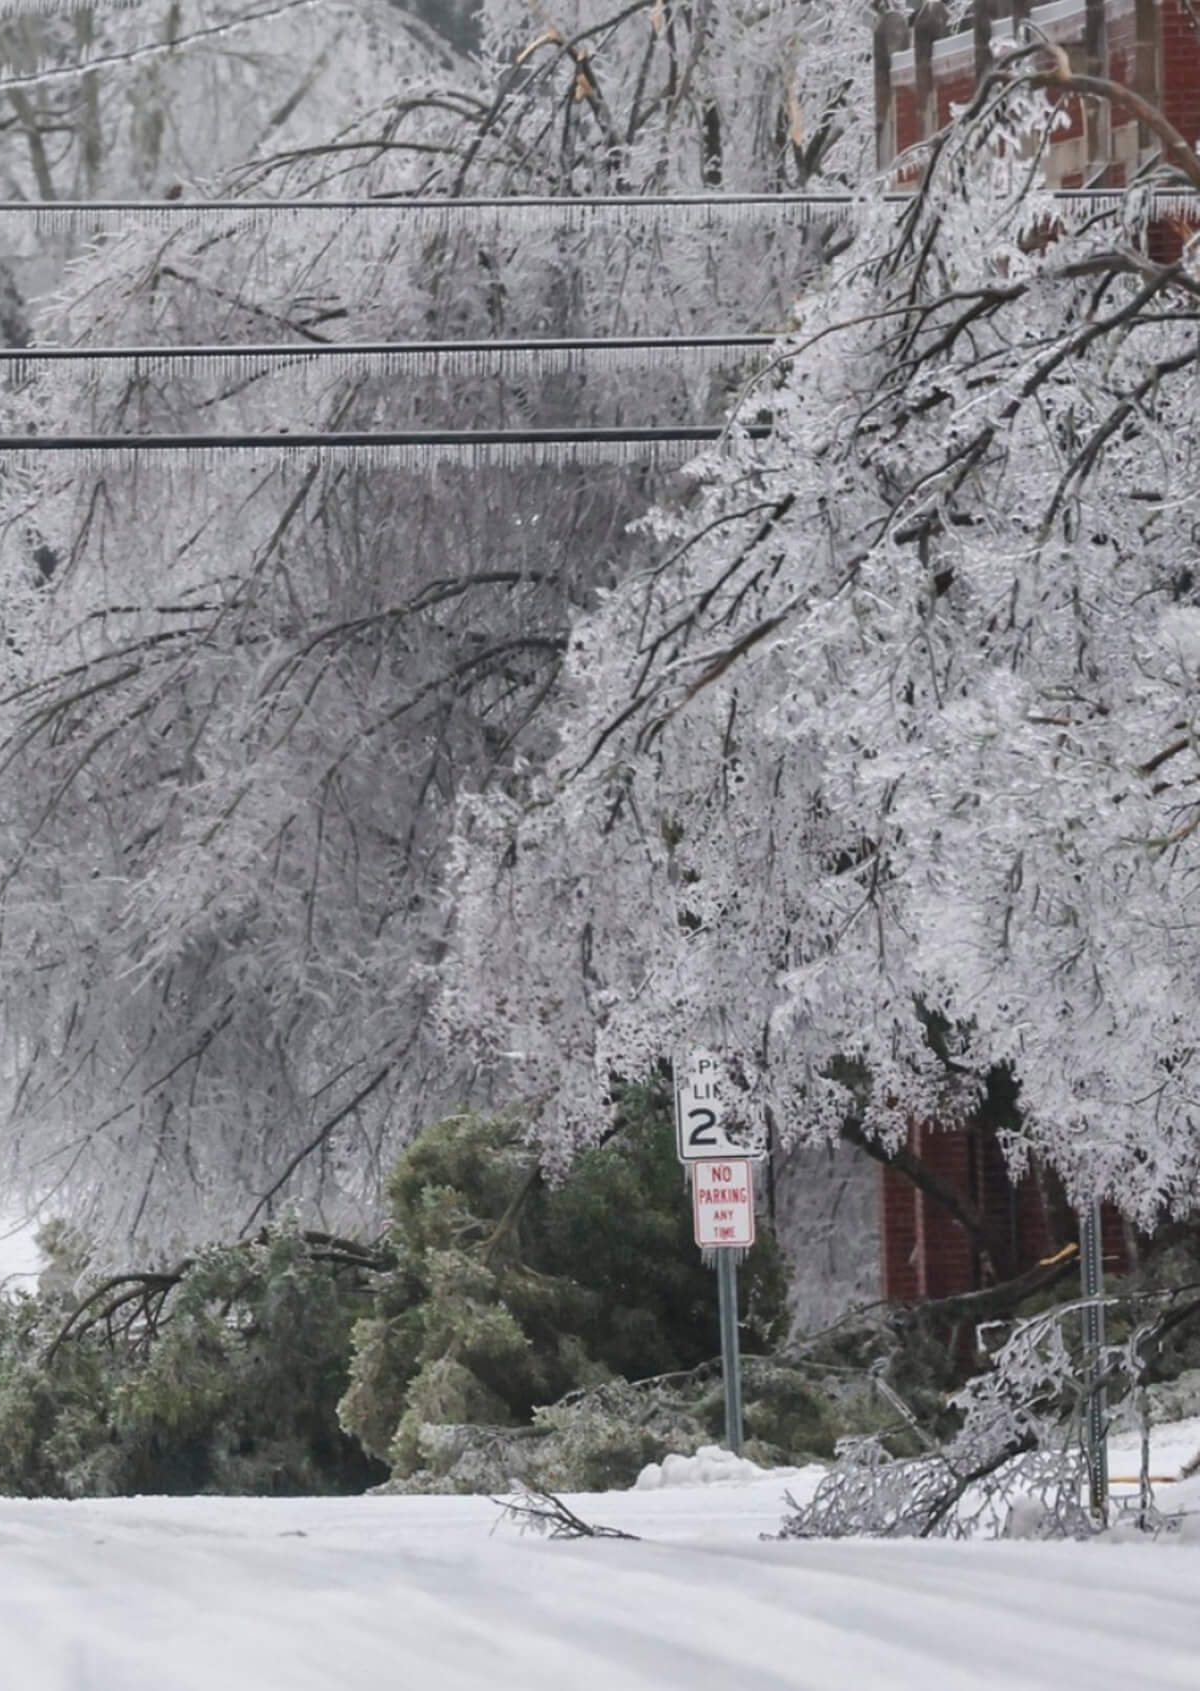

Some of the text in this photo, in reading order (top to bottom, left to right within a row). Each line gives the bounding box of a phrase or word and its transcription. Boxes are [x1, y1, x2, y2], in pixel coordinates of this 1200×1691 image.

[688, 1107, 741, 1146] 2
[712, 1166, 732, 1182] NO
[699, 1187, 746, 1204] PARKING
[713, 1210, 733, 1221] ANY
[714, 1226, 735, 1239] TIME
